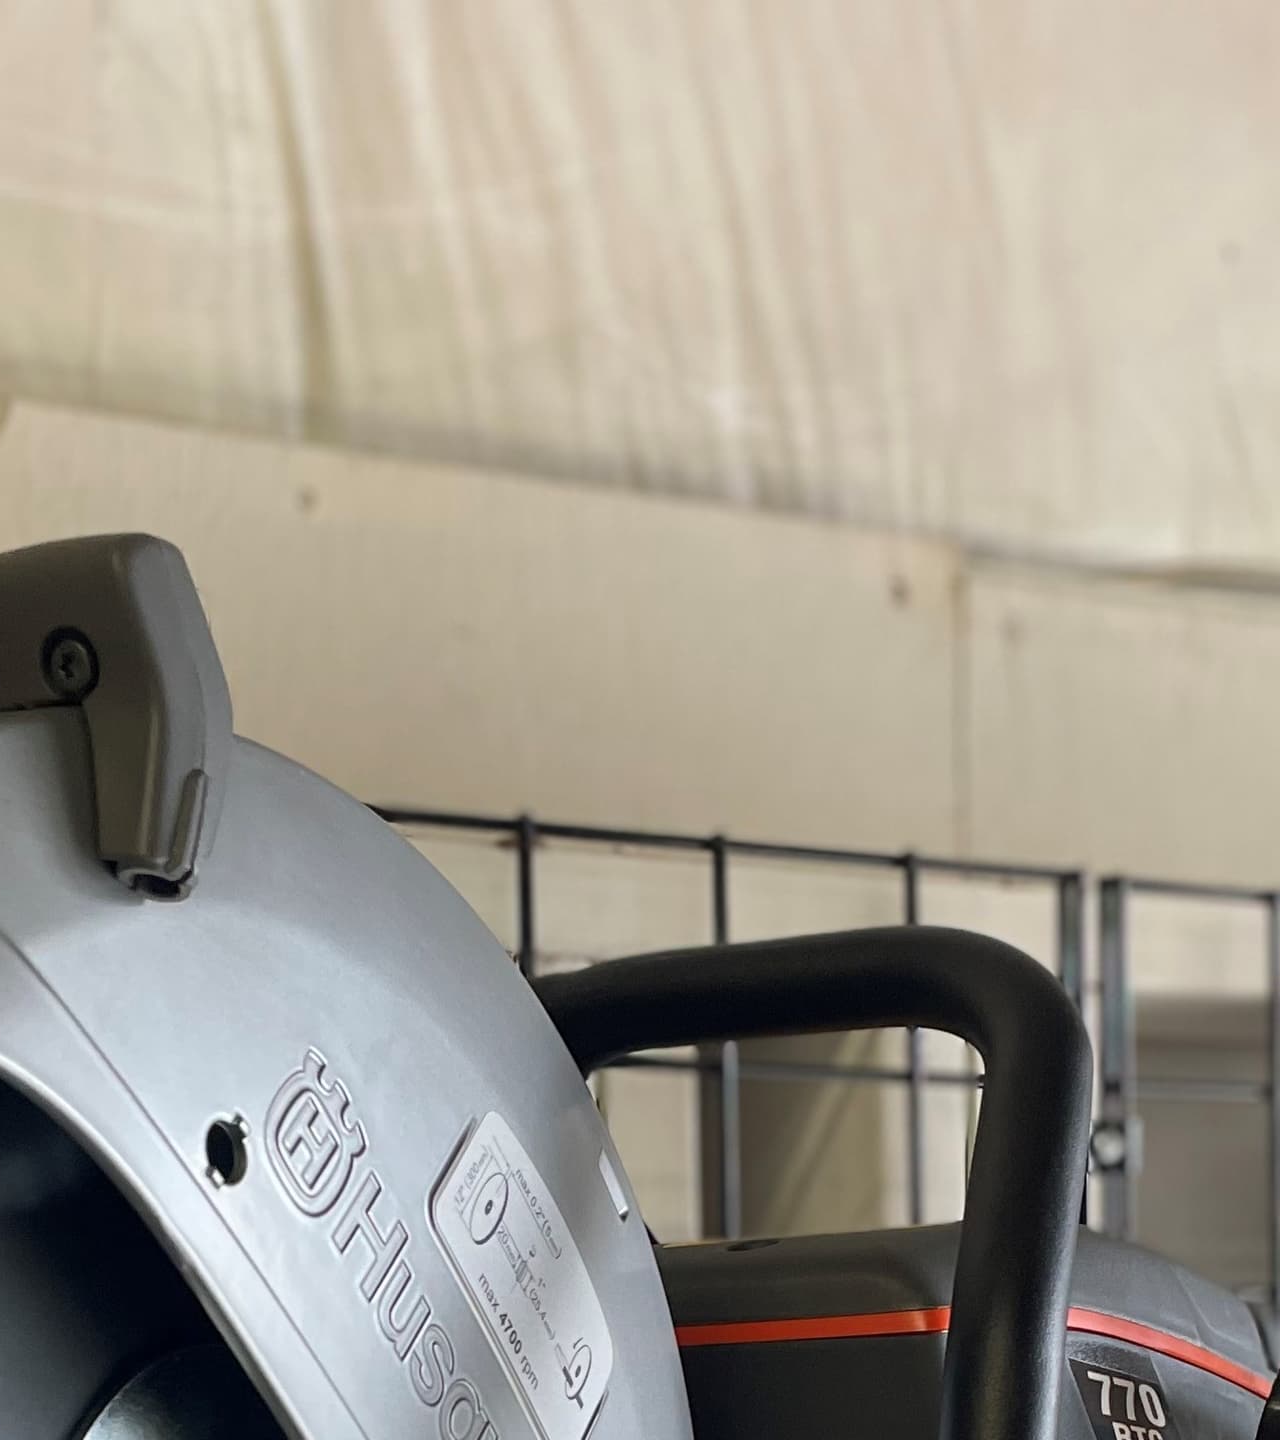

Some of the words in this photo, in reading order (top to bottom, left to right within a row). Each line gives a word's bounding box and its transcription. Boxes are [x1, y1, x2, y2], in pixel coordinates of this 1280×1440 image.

[516, 1169, 531, 1197] max
[478, 1273, 501, 1312] max
[499, 1313, 522, 1354] 4700
[521, 1356, 539, 1390] rpm
[1087, 1370, 1166, 1428] 770
